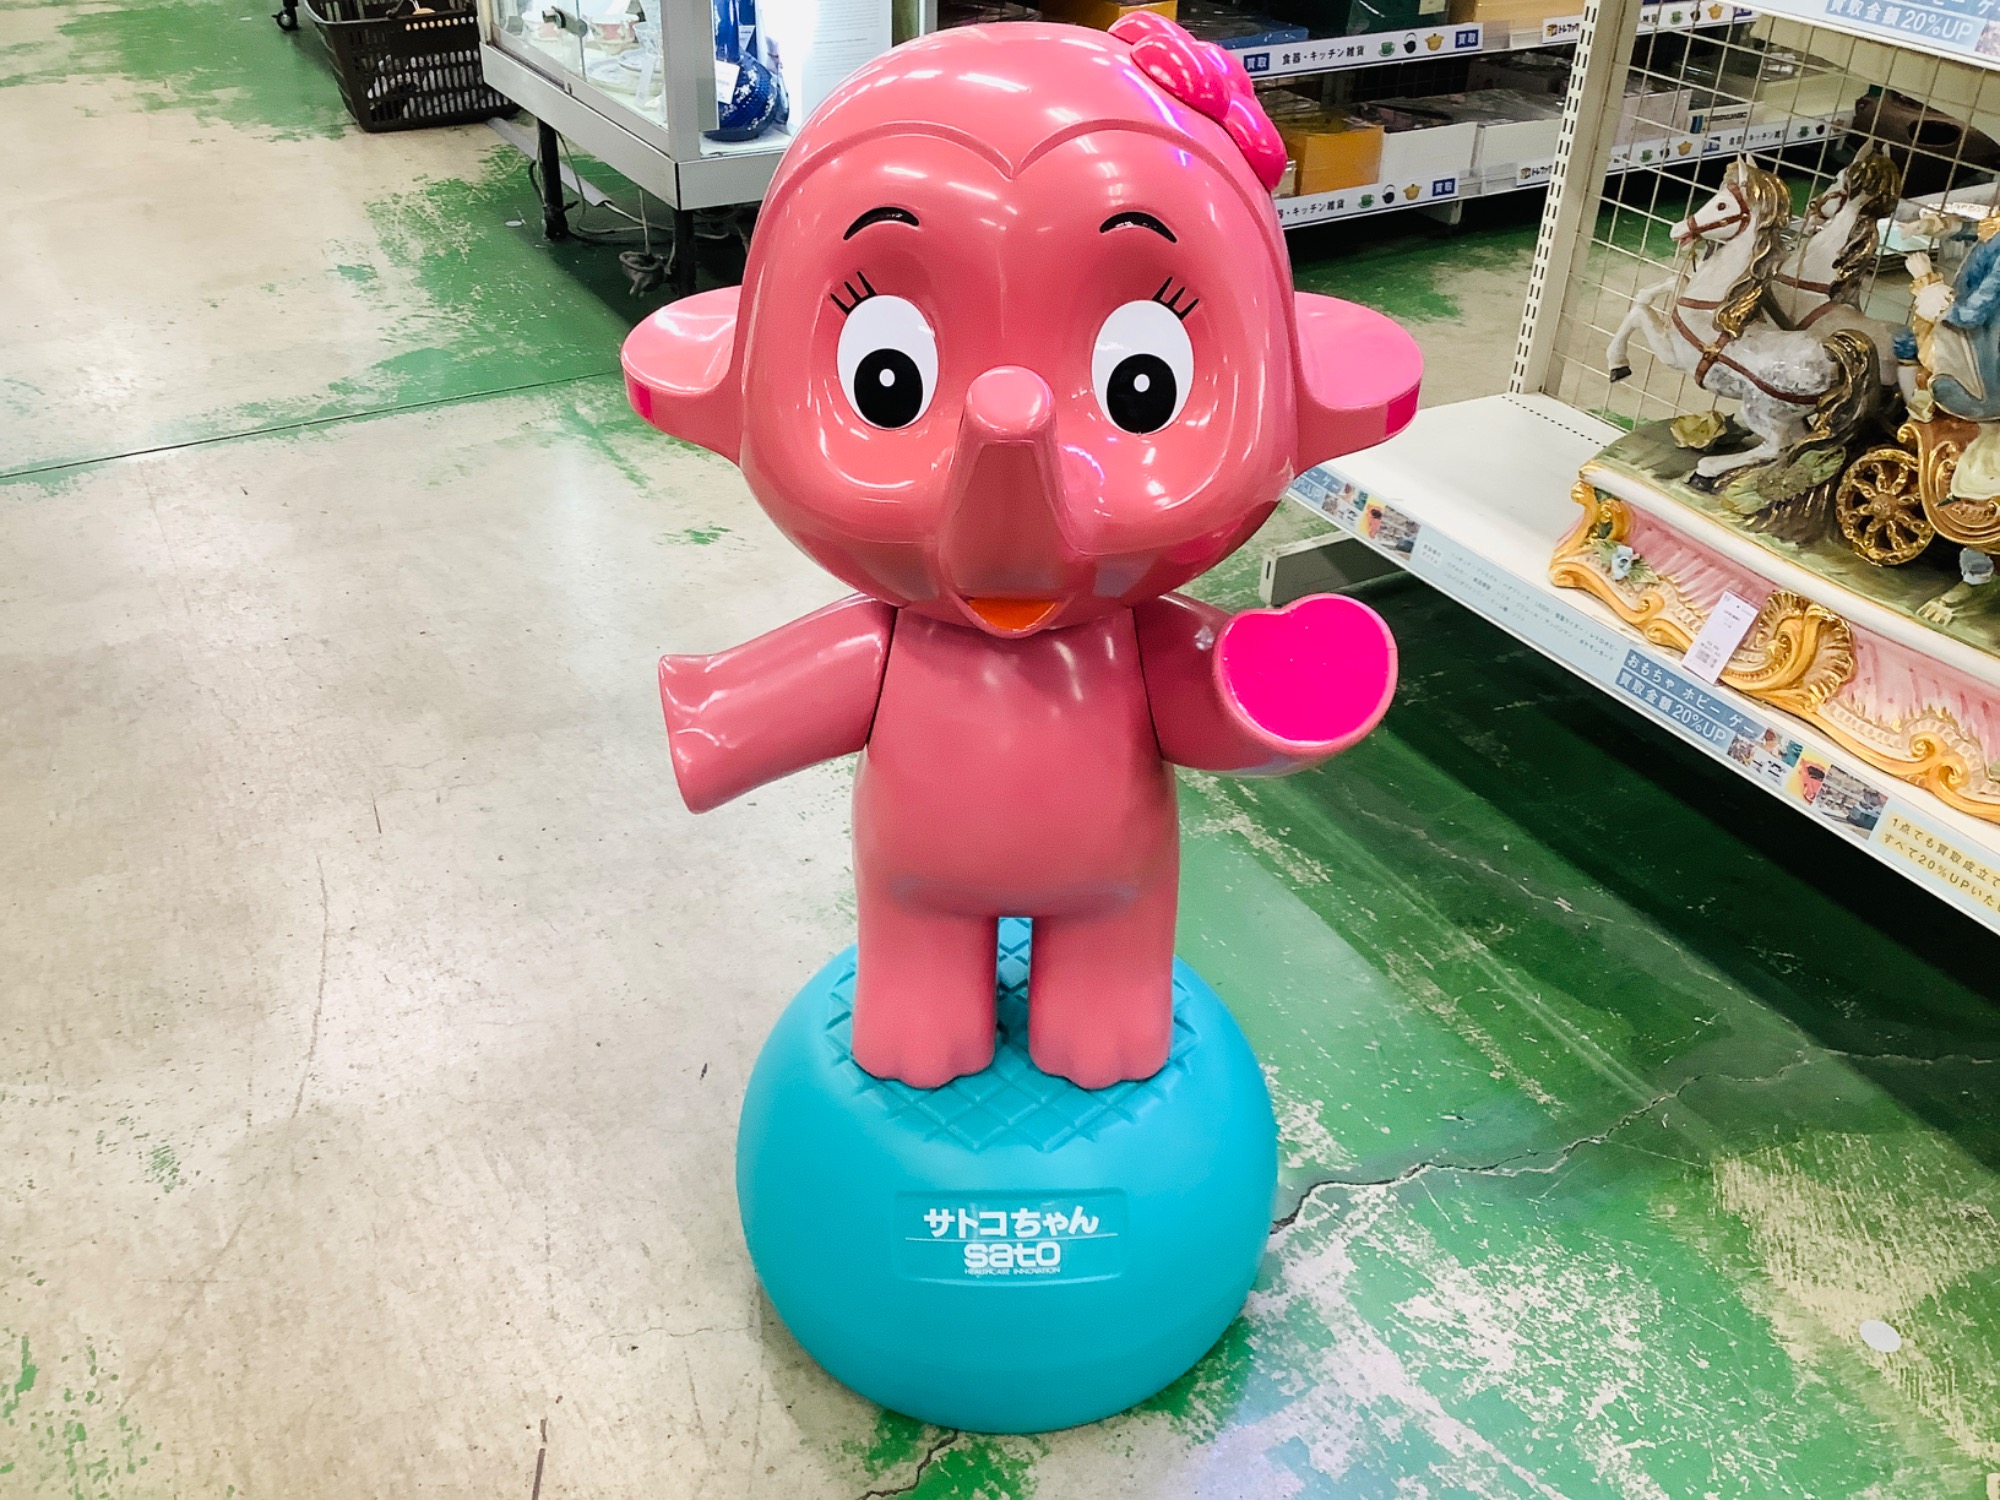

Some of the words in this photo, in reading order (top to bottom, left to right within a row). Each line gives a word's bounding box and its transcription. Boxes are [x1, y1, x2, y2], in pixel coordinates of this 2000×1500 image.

[1246, 55, 1268, 71] 買取
[1282, 45, 1366, 66] 食器・キッチン雑貨
[1457, 31, 1477, 46] 買取
[1434, 180, 1454, 196] 買取
[1626, 654, 1675, 689] おもちゃ
[1682, 687, 1721, 714] ホビー
[1617, 671, 1727, 742] 買取金額20%UP
[923, 1205, 1099, 1239] サトコちゃん
[963, 1240, 1061, 1268] sato
